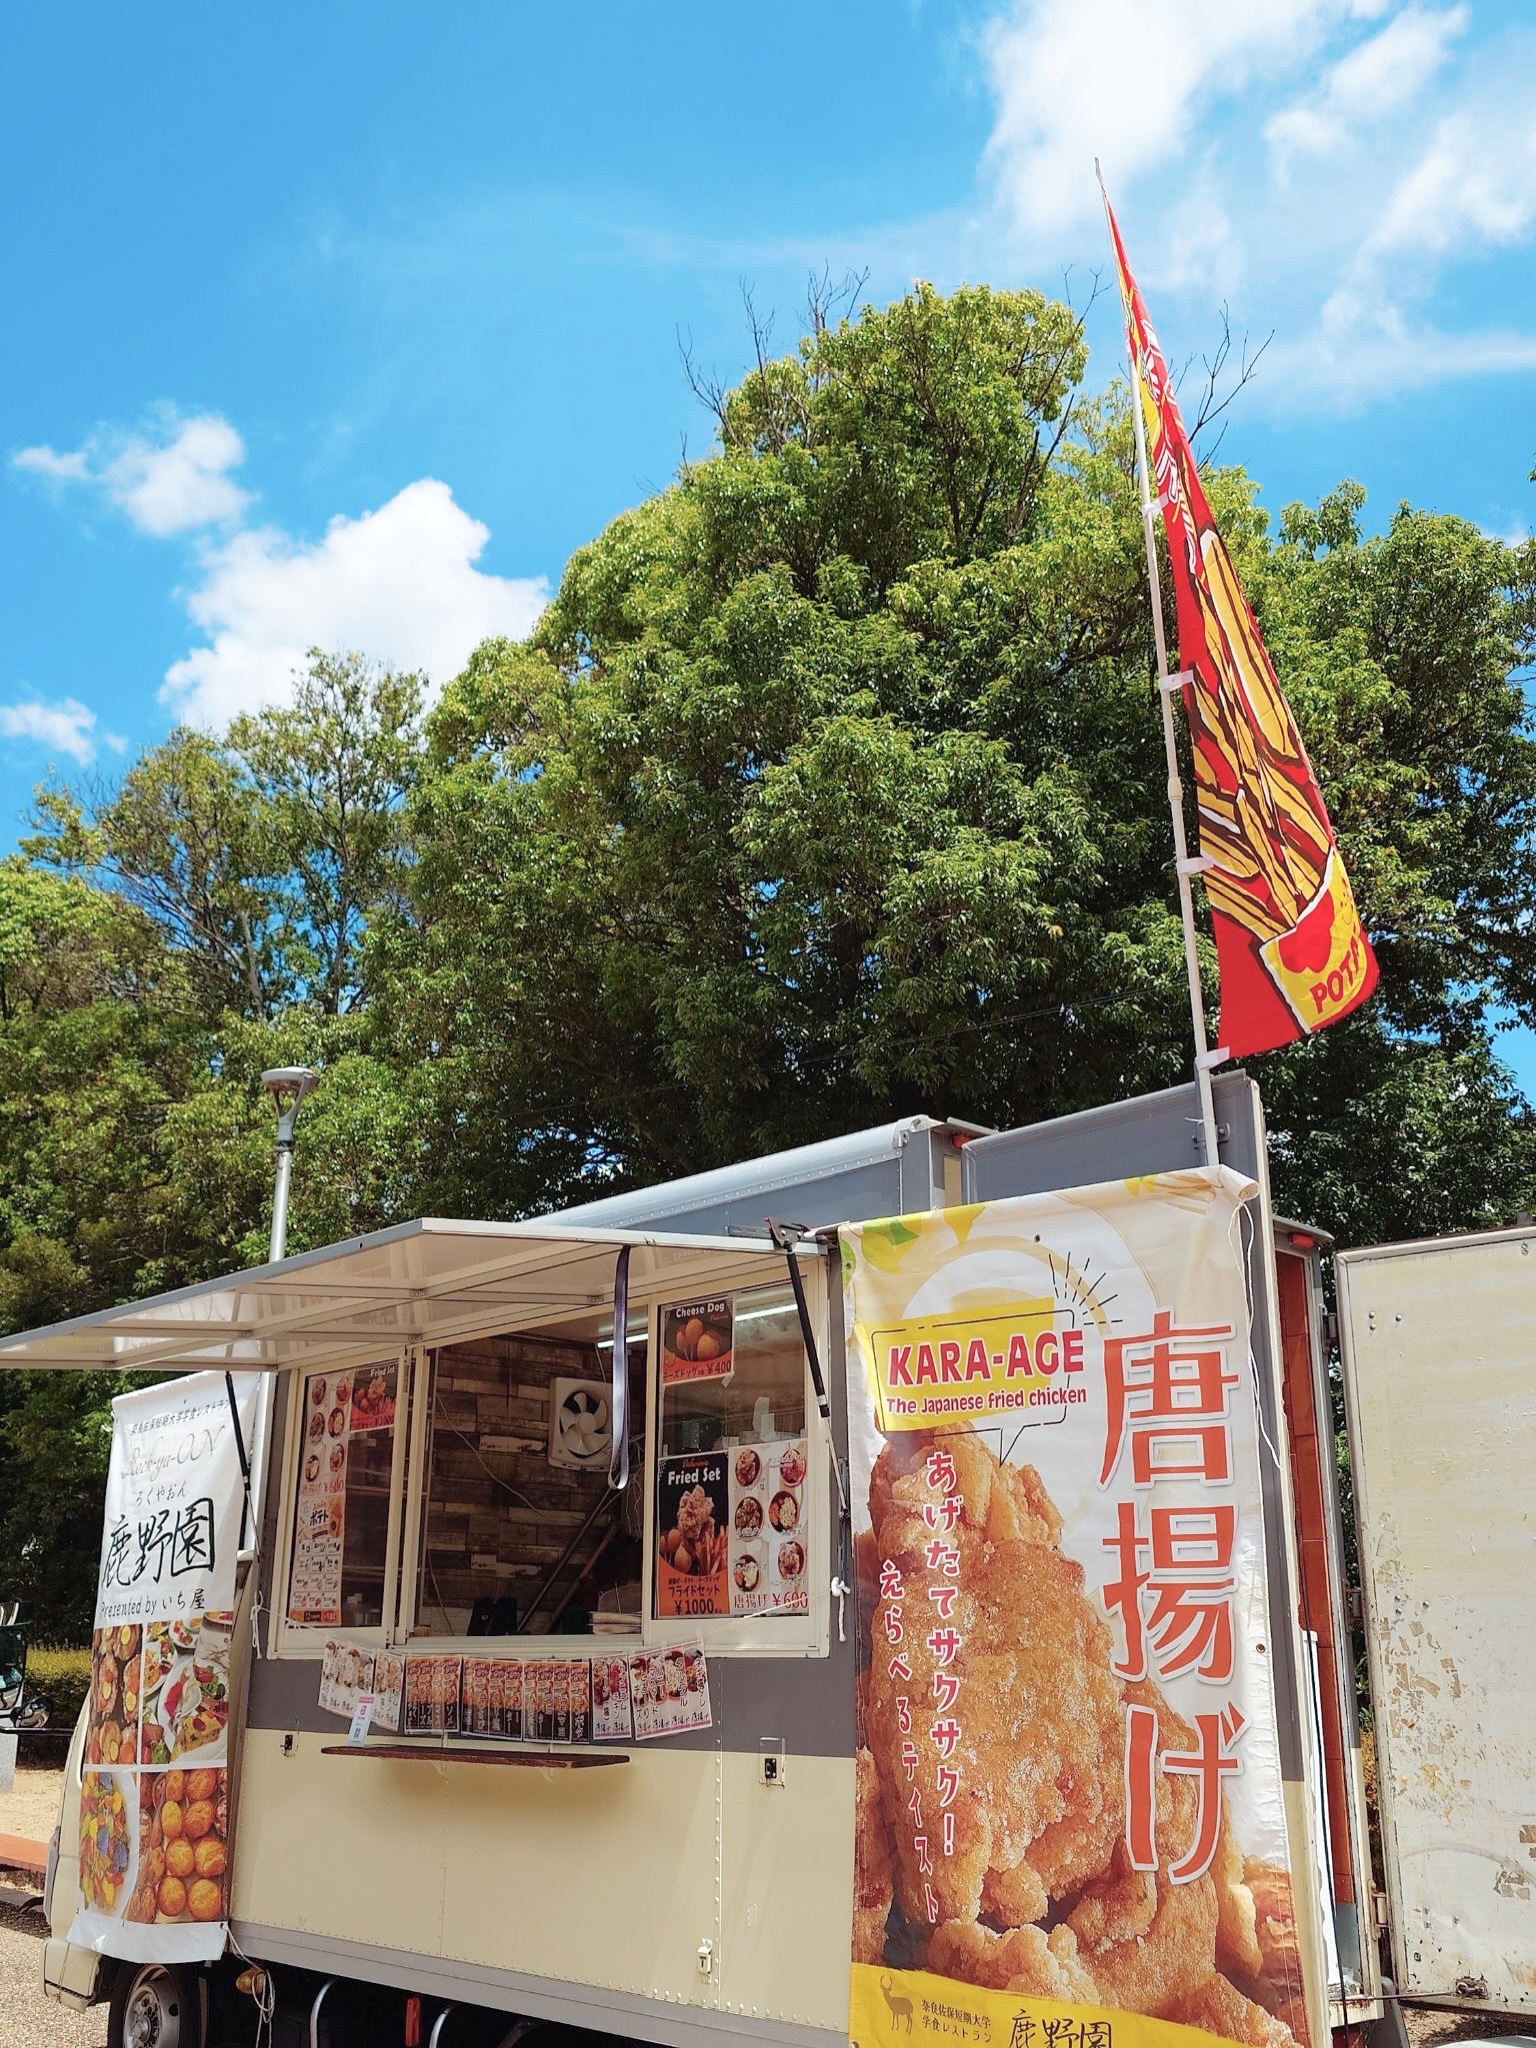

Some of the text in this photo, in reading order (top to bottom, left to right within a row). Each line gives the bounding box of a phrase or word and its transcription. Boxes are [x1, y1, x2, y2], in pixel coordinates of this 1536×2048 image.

[676, 1302, 725, 1318] Cheese Dog
[707, 1361, 732, 1375] ¥400
[888, 1330, 1085, 1387] KARA-AGE
[370, 1367, 386, 1378] Fried
[886, 1387, 1087, 1415] The Japanese fried chicken
[668, 1466, 721, 1485] Fried Set
[136, 1481, 186, 1506] ろくやおん
[310, 1509, 329, 1526] ポテト
[101, 1498, 215, 1588] 鹿野園
[669, 1584, 720, 1598] フライドセット
[734, 1592, 768, 1609] 唐揚げ
[772, 1591, 808, 1609] ¥600
[1098, 1309, 1248, 1884] 唐揚げ
[101, 1588, 205, 1618] Presented by いち屋
[674, 1598, 714, 1614] ¥1000
[921, 1999, 992, 2027] 奈良佐保短期大学
[921, 2014, 992, 2043] 学食レストラン
[1010, 2008, 1112, 2048] 鹿野園
